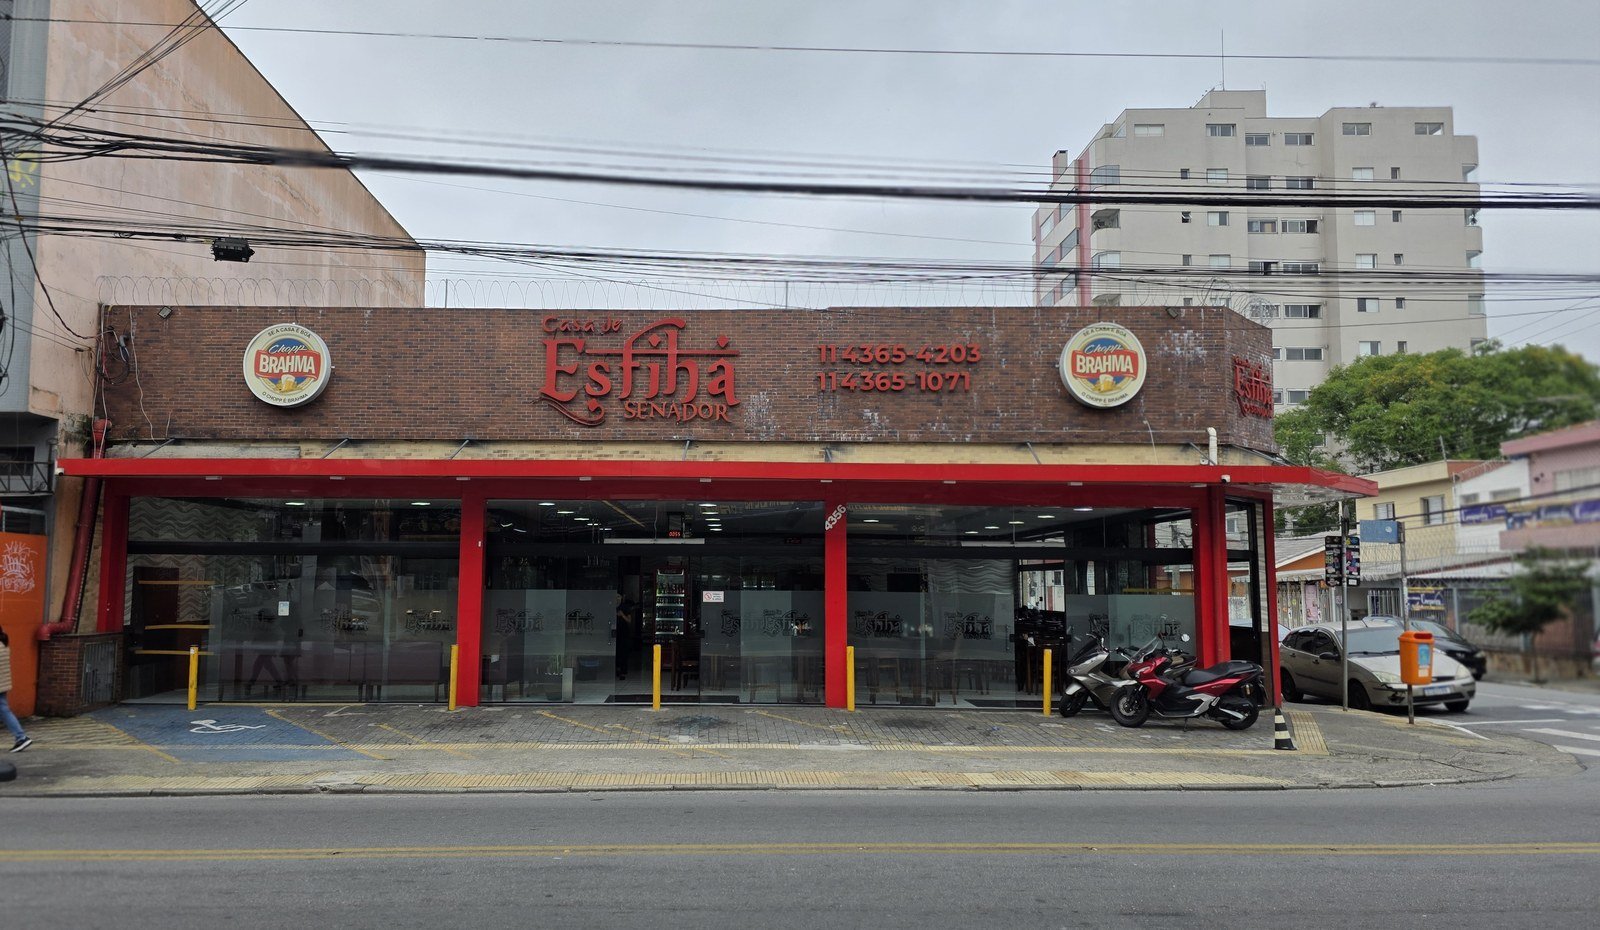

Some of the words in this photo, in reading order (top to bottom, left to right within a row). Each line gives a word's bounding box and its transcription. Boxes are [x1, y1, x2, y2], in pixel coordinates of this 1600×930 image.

[541, 315, 595, 333] Casa
[259, 354, 316, 374] BRAHMA
[539, 317, 741, 407] Esfiha
[817, 343, 838, 363] 11
[841, 343, 982, 364] 4365-4203
[1075, 354, 1134, 374] BRAHMA
[817, 371, 838, 391] 11
[841, 371, 971, 392] 4365-1071
[623, 399, 732, 423] SENADOR
[824, 504, 846, 531] 4356
